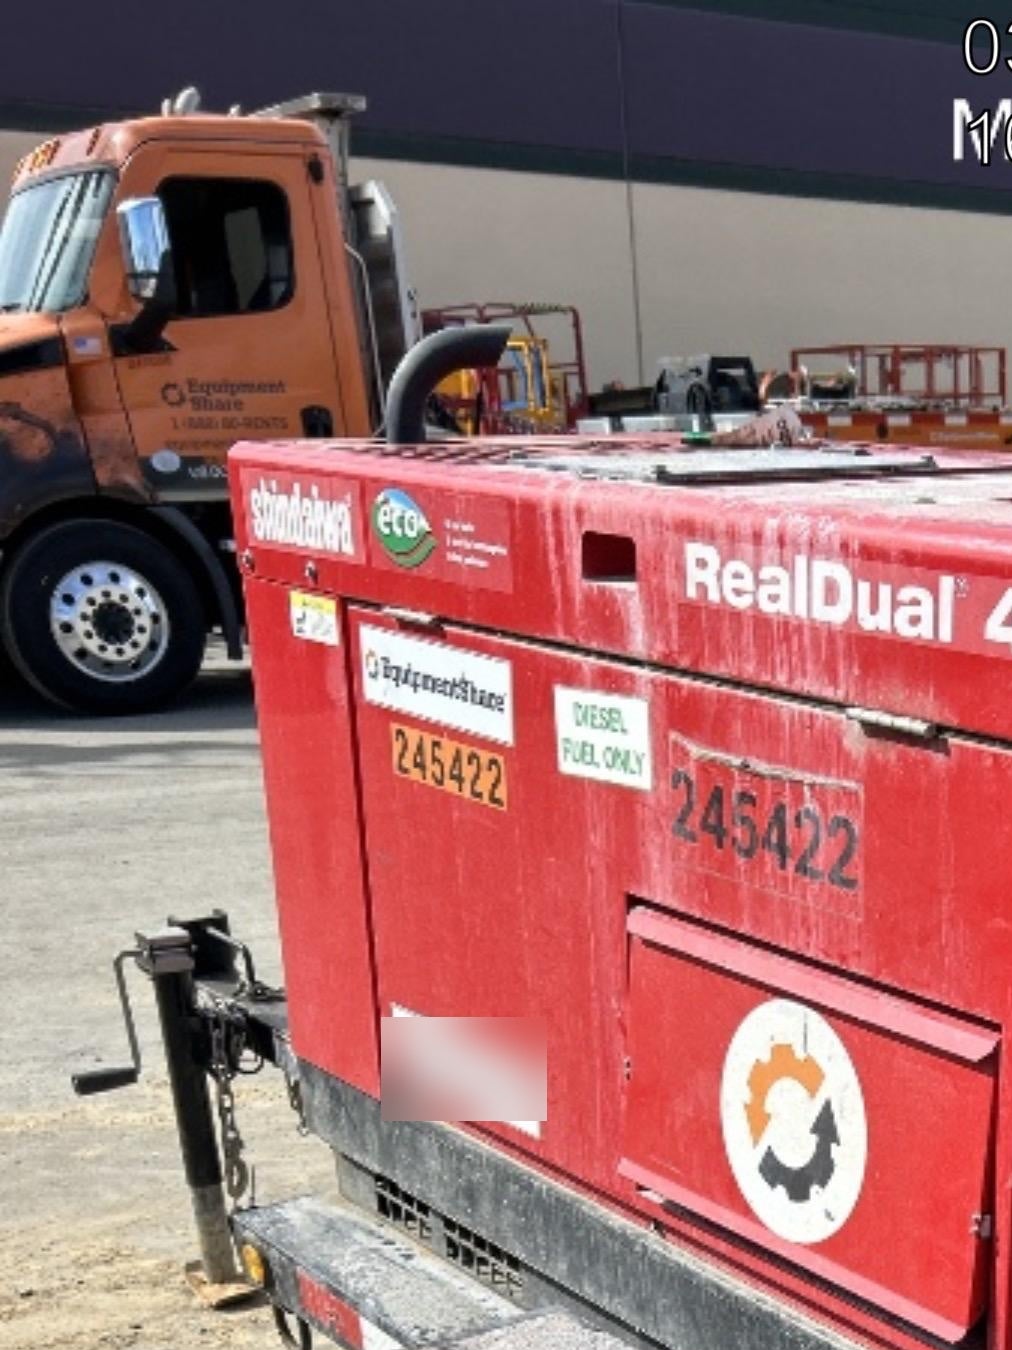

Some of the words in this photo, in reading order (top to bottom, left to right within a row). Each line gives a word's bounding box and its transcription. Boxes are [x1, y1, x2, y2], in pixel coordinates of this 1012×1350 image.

[251, 476, 354, 556] shindaiwa
[379, 506, 418, 538] eco
[380, 656, 505, 713] EquipmentShare
[572, 701, 628, 734] DIESEL
[395, 728, 505, 809] 245422
[562, 737, 598, 768] FUEL
[603, 745, 645, 776] ONLY
[670, 770, 859, 890] 245422
